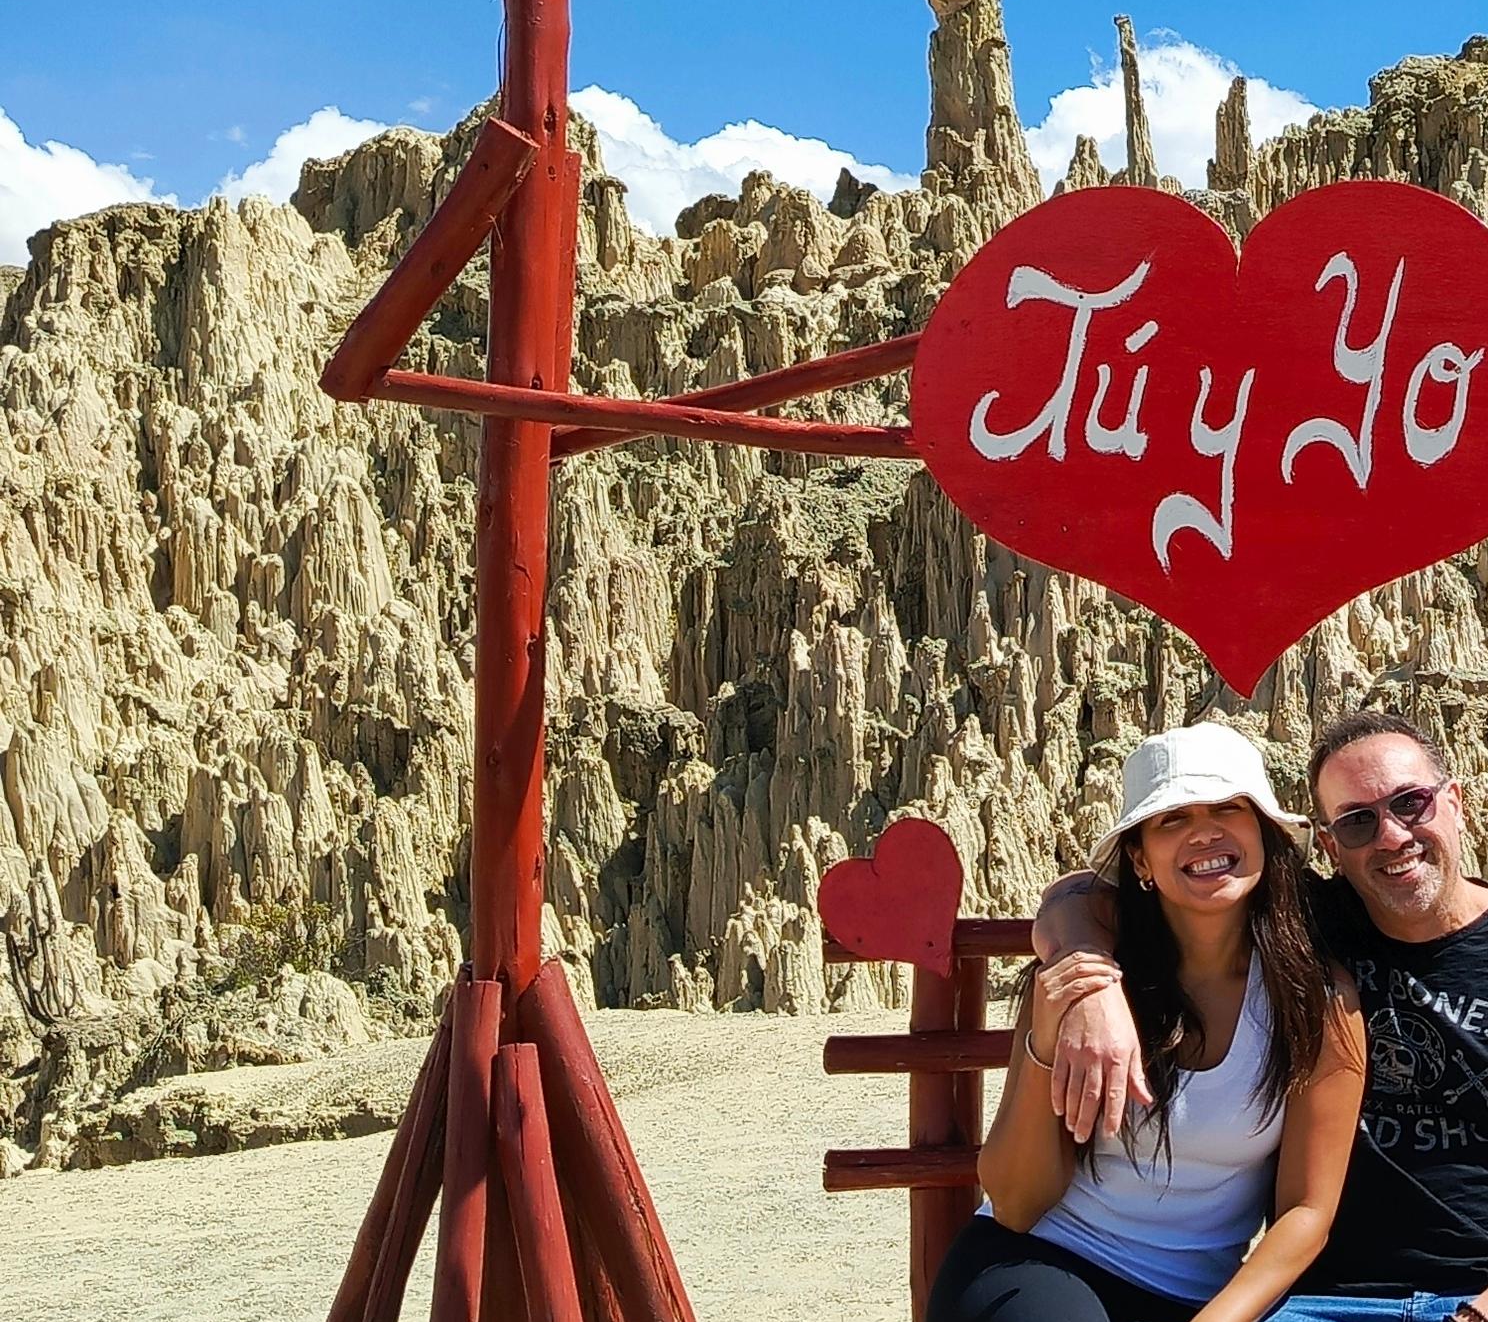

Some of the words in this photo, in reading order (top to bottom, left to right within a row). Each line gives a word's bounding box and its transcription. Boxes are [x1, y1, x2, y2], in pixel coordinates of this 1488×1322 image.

[969, 257, 1159, 463] Tú
[1153, 365, 1256, 575] y
[1281, 251, 1485, 490] Yo
